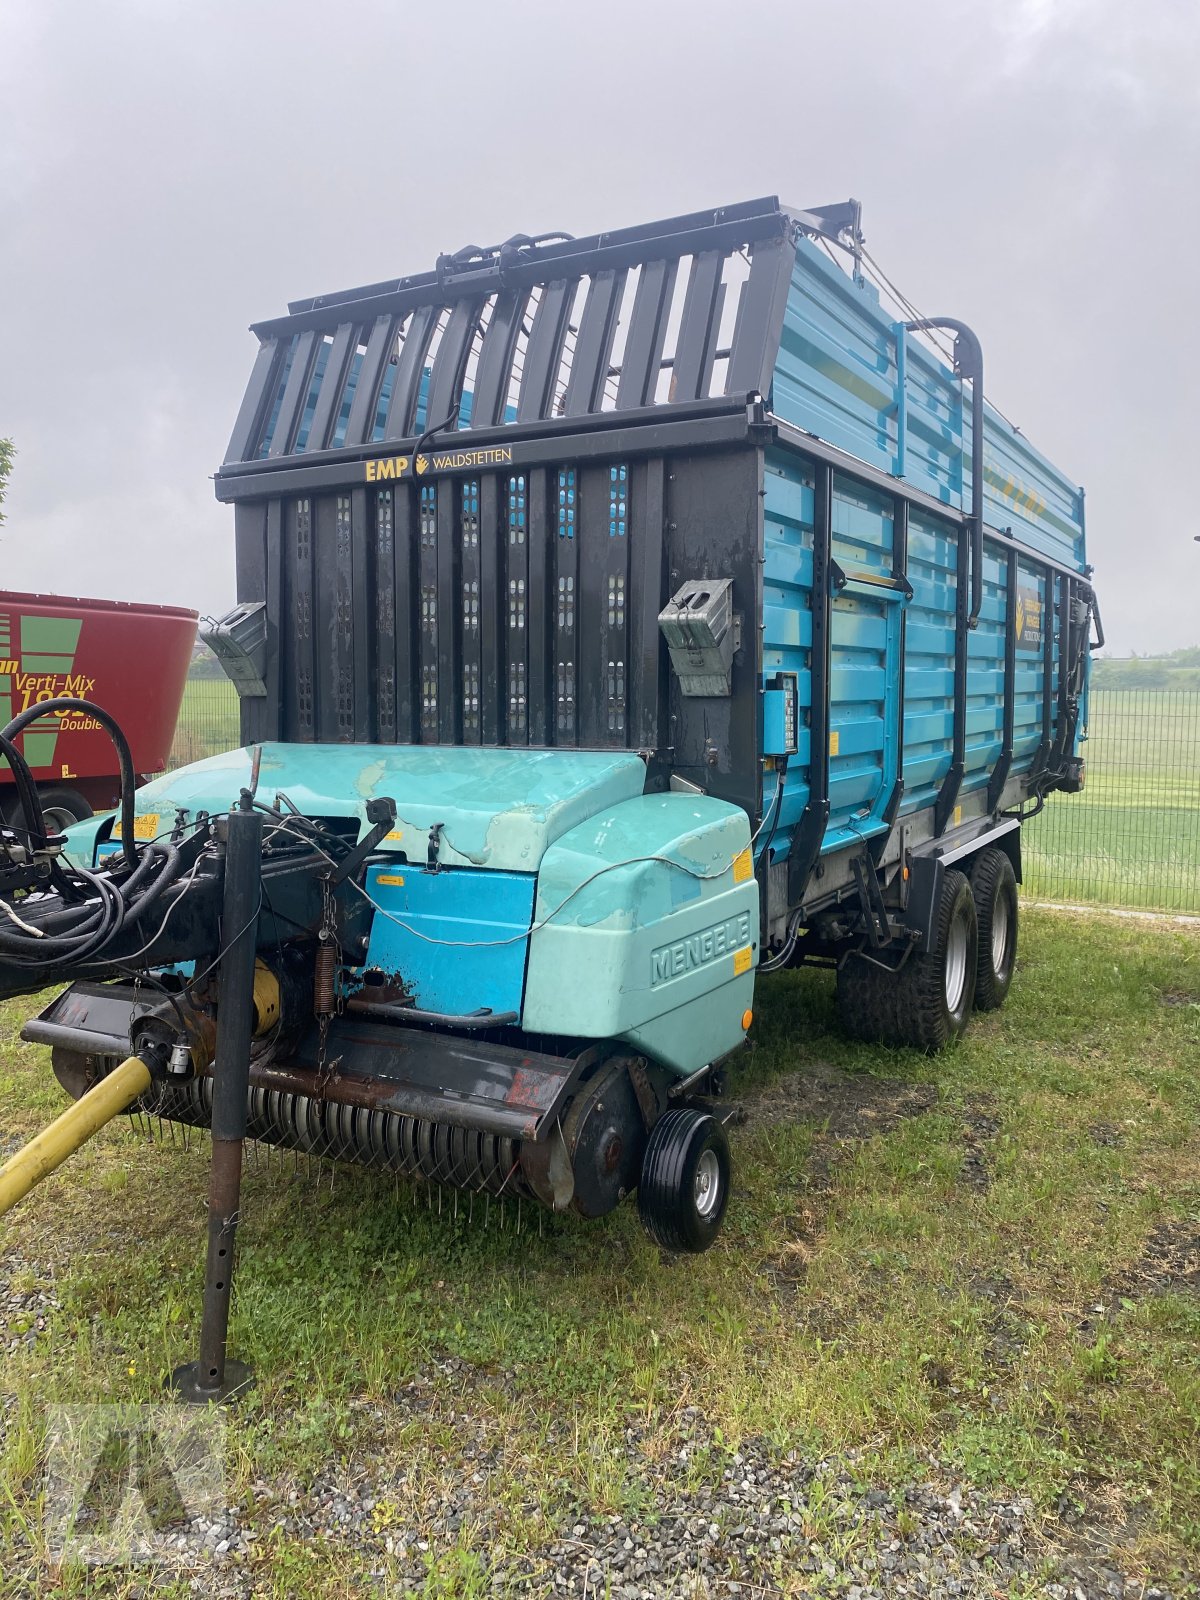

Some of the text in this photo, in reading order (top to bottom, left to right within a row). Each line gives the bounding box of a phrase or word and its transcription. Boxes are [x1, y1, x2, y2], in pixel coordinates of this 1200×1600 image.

[365, 448, 512, 482] EMP WALDSTETTEN
[15, 673, 95, 691] Verti-Mix
[59, 717, 103, 731] Double
[651, 915, 750, 985] MENGELE
